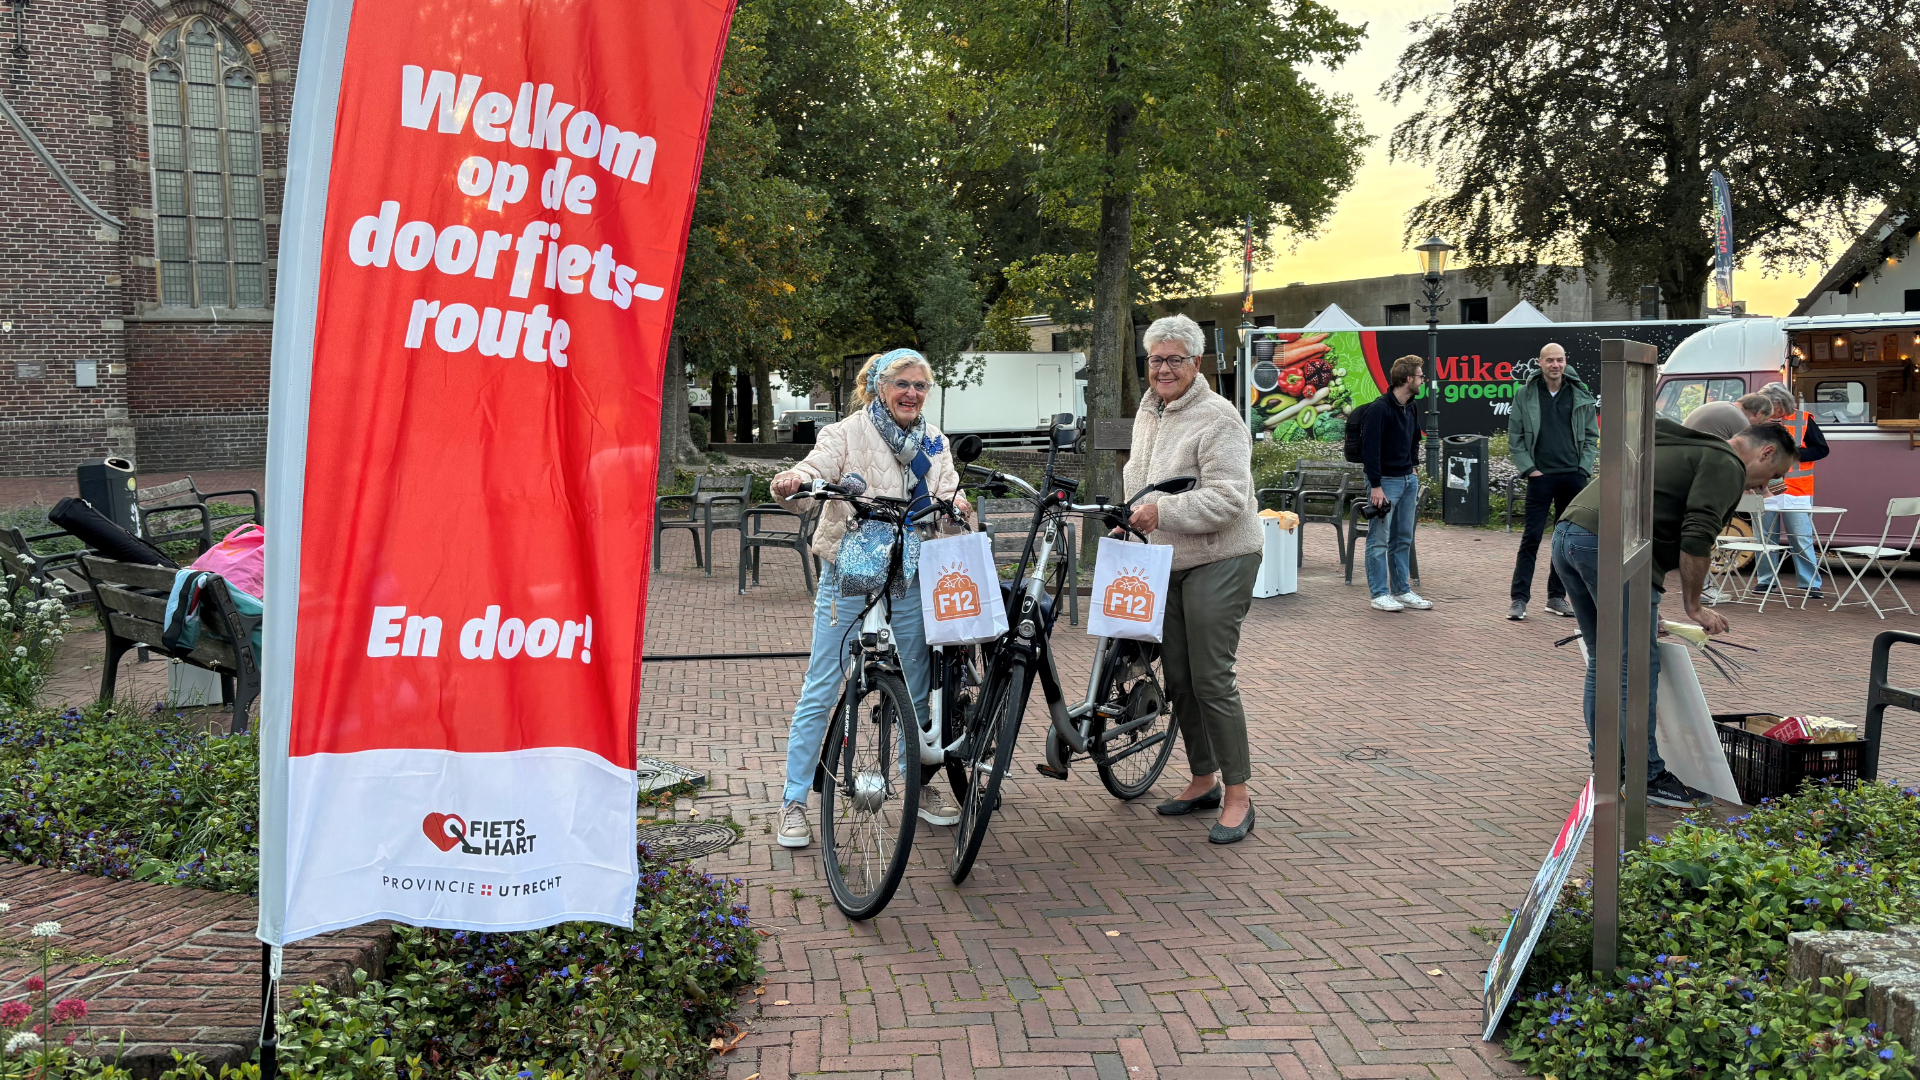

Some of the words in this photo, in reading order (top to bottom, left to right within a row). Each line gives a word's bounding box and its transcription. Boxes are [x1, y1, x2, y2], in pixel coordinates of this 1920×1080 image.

[402, 64, 657, 185] Welkom
[457, 155, 529, 213] op
[541, 157, 596, 214] de
[349, 200, 664, 309] doorfiets-
[405, 299, 570, 367] route
[1428, 355, 1512, 382] Mike
[1444, 380, 1523, 403] groent
[938, 590, 975, 615] F12
[1110, 591, 1147, 615] F12
[367, 605, 443, 658] En
[460, 604, 593, 664] door!
[471, 818, 526, 838] FIETS
[485, 834, 536, 856] HART
[383, 875, 476, 895] PROVINCIE
[499, 876, 562, 897] UTRECHT
